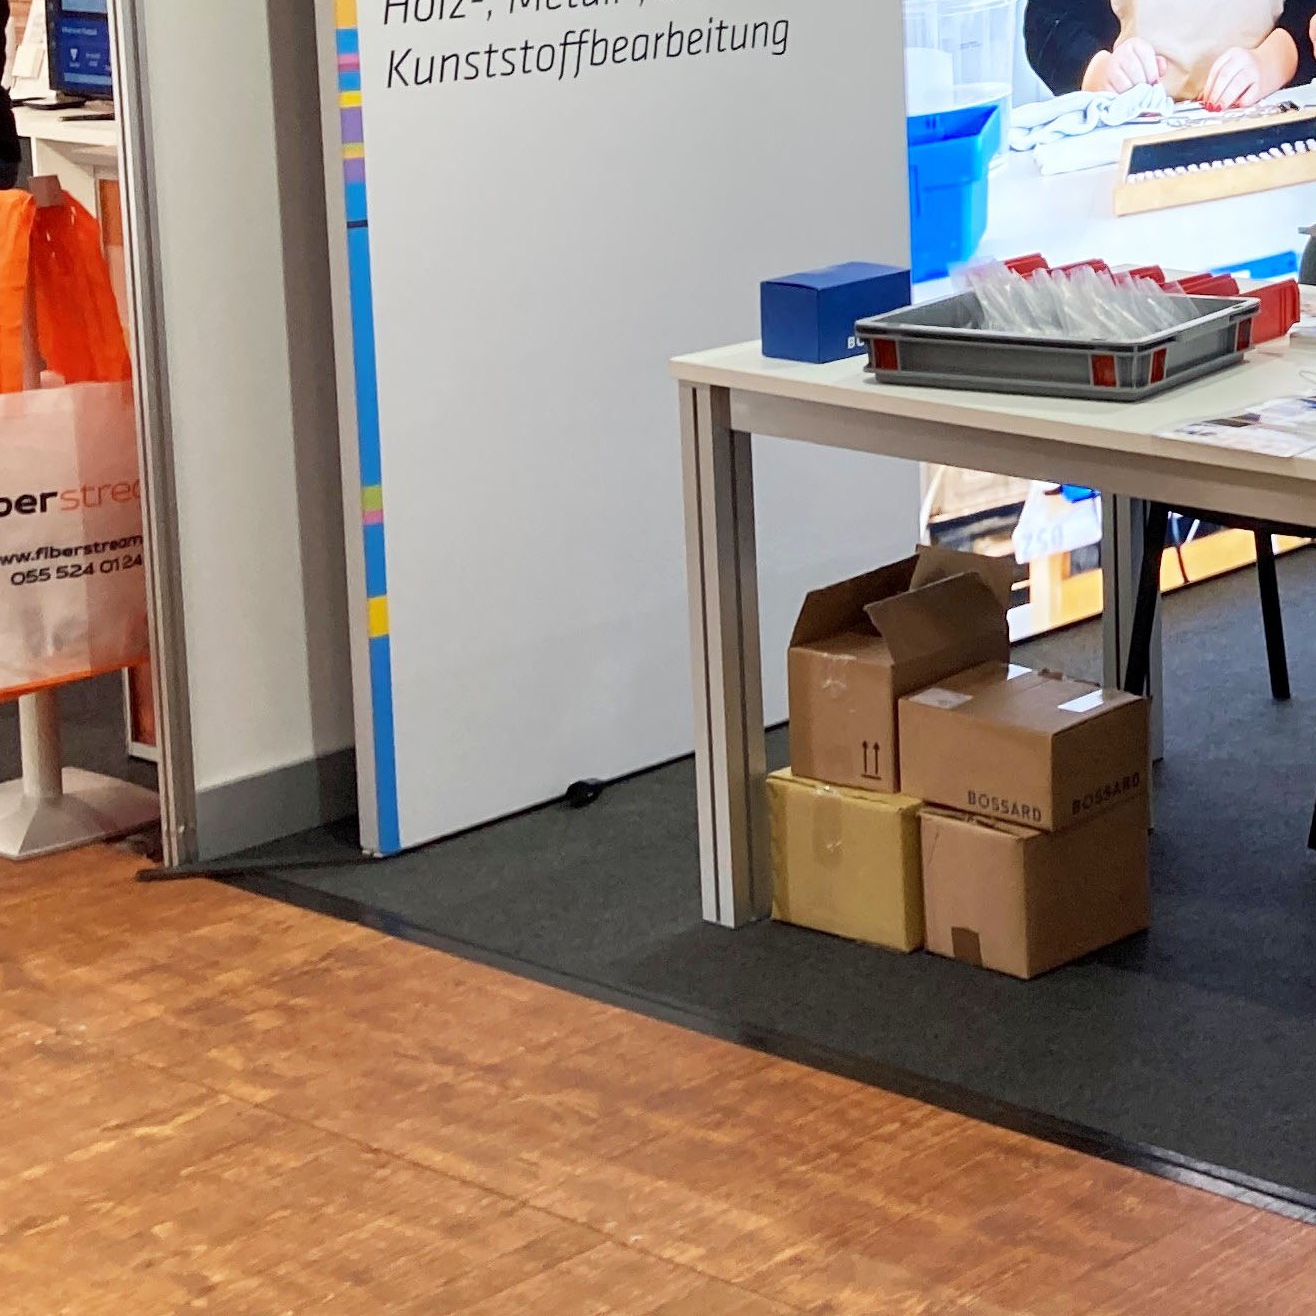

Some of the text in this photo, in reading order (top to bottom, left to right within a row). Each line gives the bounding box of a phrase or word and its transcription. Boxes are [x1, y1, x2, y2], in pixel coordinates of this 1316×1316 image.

[386, 17, 790, 88] Kunststoffbearbeitung
[11, 567, 51, 586] 055
[56, 562, 95, 580] 524
[967, 790, 1042, 822] BOSSARD
[1071, 771, 1142, 816] BOSSARD
